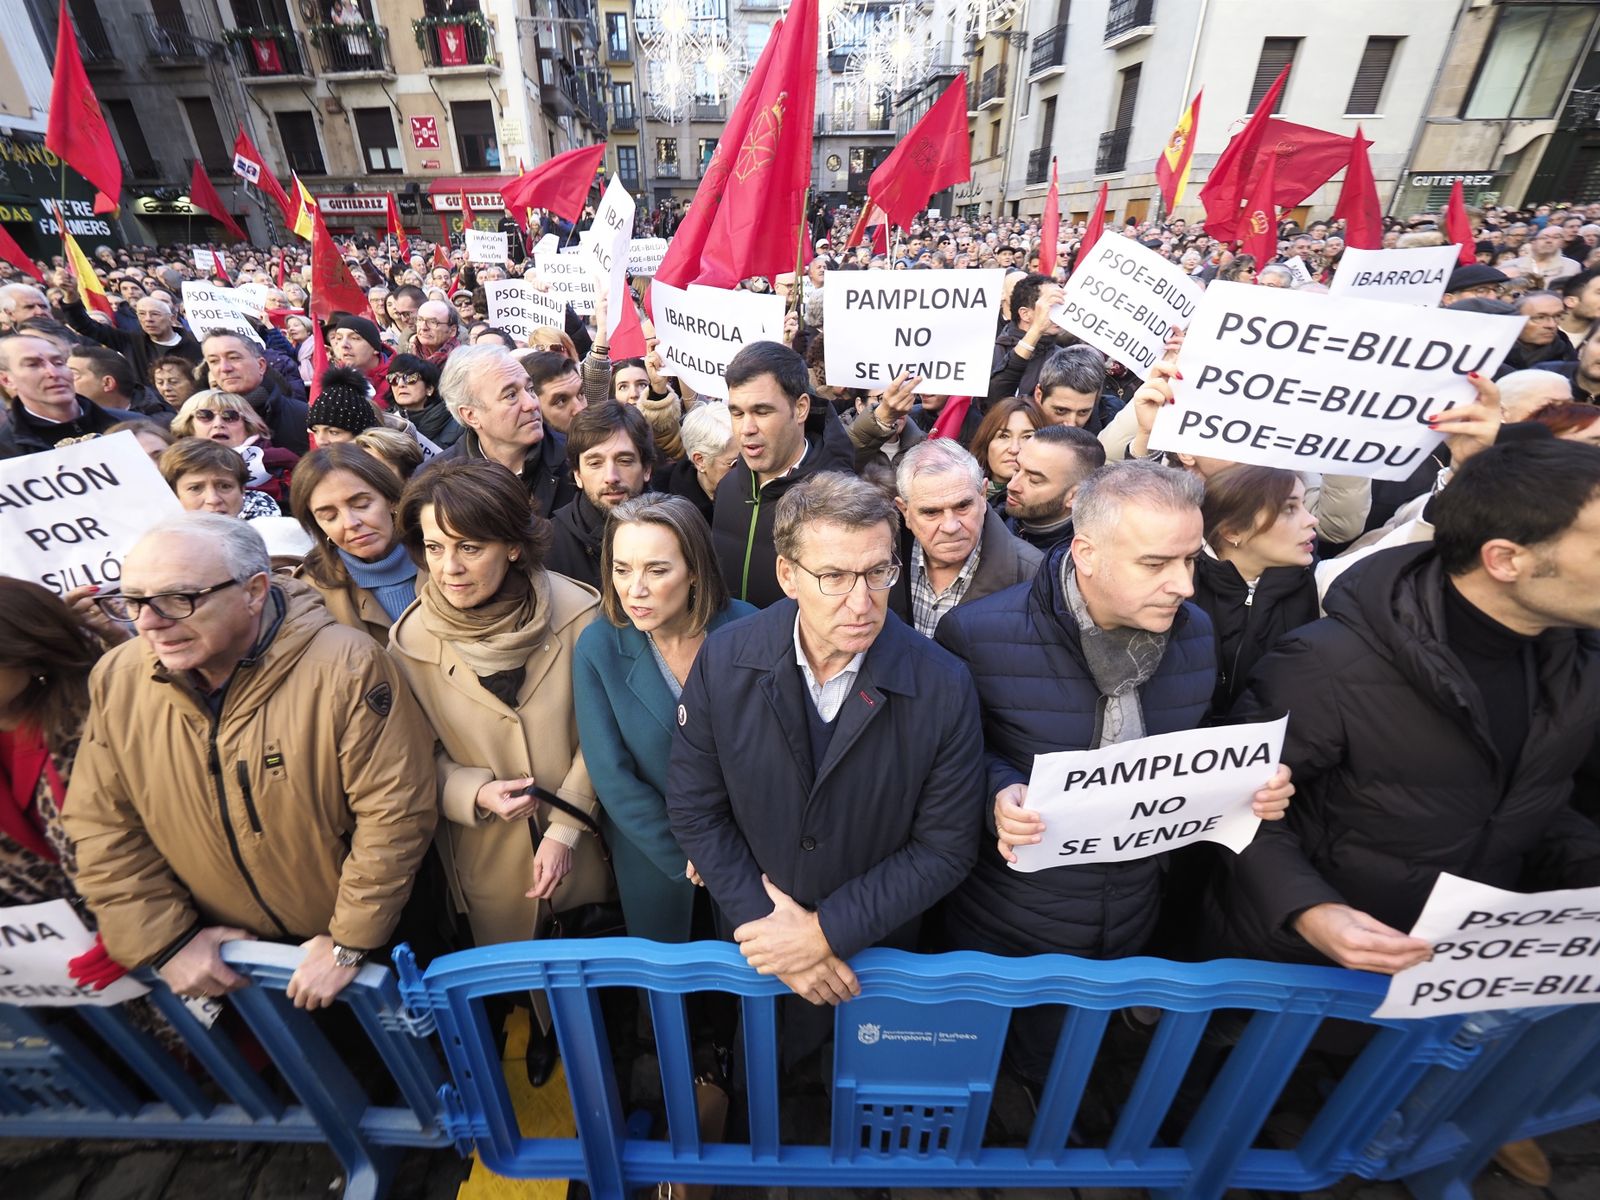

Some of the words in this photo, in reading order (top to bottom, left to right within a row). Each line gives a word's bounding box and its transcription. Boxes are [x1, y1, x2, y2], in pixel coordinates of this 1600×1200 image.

[329, 199, 383, 209] GUTIERREZ
[1099, 248, 1196, 318] PSOE=BILDU
[1352, 268, 1444, 287] IBARROLA
[495, 288, 563, 314] PSOE=BILDU
[846, 287, 988, 310] PAMPLONA
[1080, 275, 1177, 345] PSOE=BILDU
[665, 307, 743, 344] IBARROLA
[895, 327, 932, 347] NO
[1063, 302, 1157, 369] PSOE=BILDU
[1216, 312, 1494, 376] PSOE=BILDU
[666, 345, 727, 378] ALCALDE
[855, 362, 880, 380] SE
[888, 360, 966, 381] VENDE
[1195, 364, 1455, 426] PSOE=BILDU
[1177, 410, 1421, 467] PSOE=BILDU
[25, 516, 109, 552] POR
[41, 551, 124, 596] SILLÓ
[1063, 742, 1270, 792] PAMPLONA
[1130, 796, 1186, 820] NO
[1058, 838, 1101, 856] SE
[1113, 815, 1223, 852] VENDE
[1457, 908, 1600, 931] PSOE=
[1410, 974, 1600, 1007] PSOE=BIL
[881, 1033, 933, 1042] Pamplona
